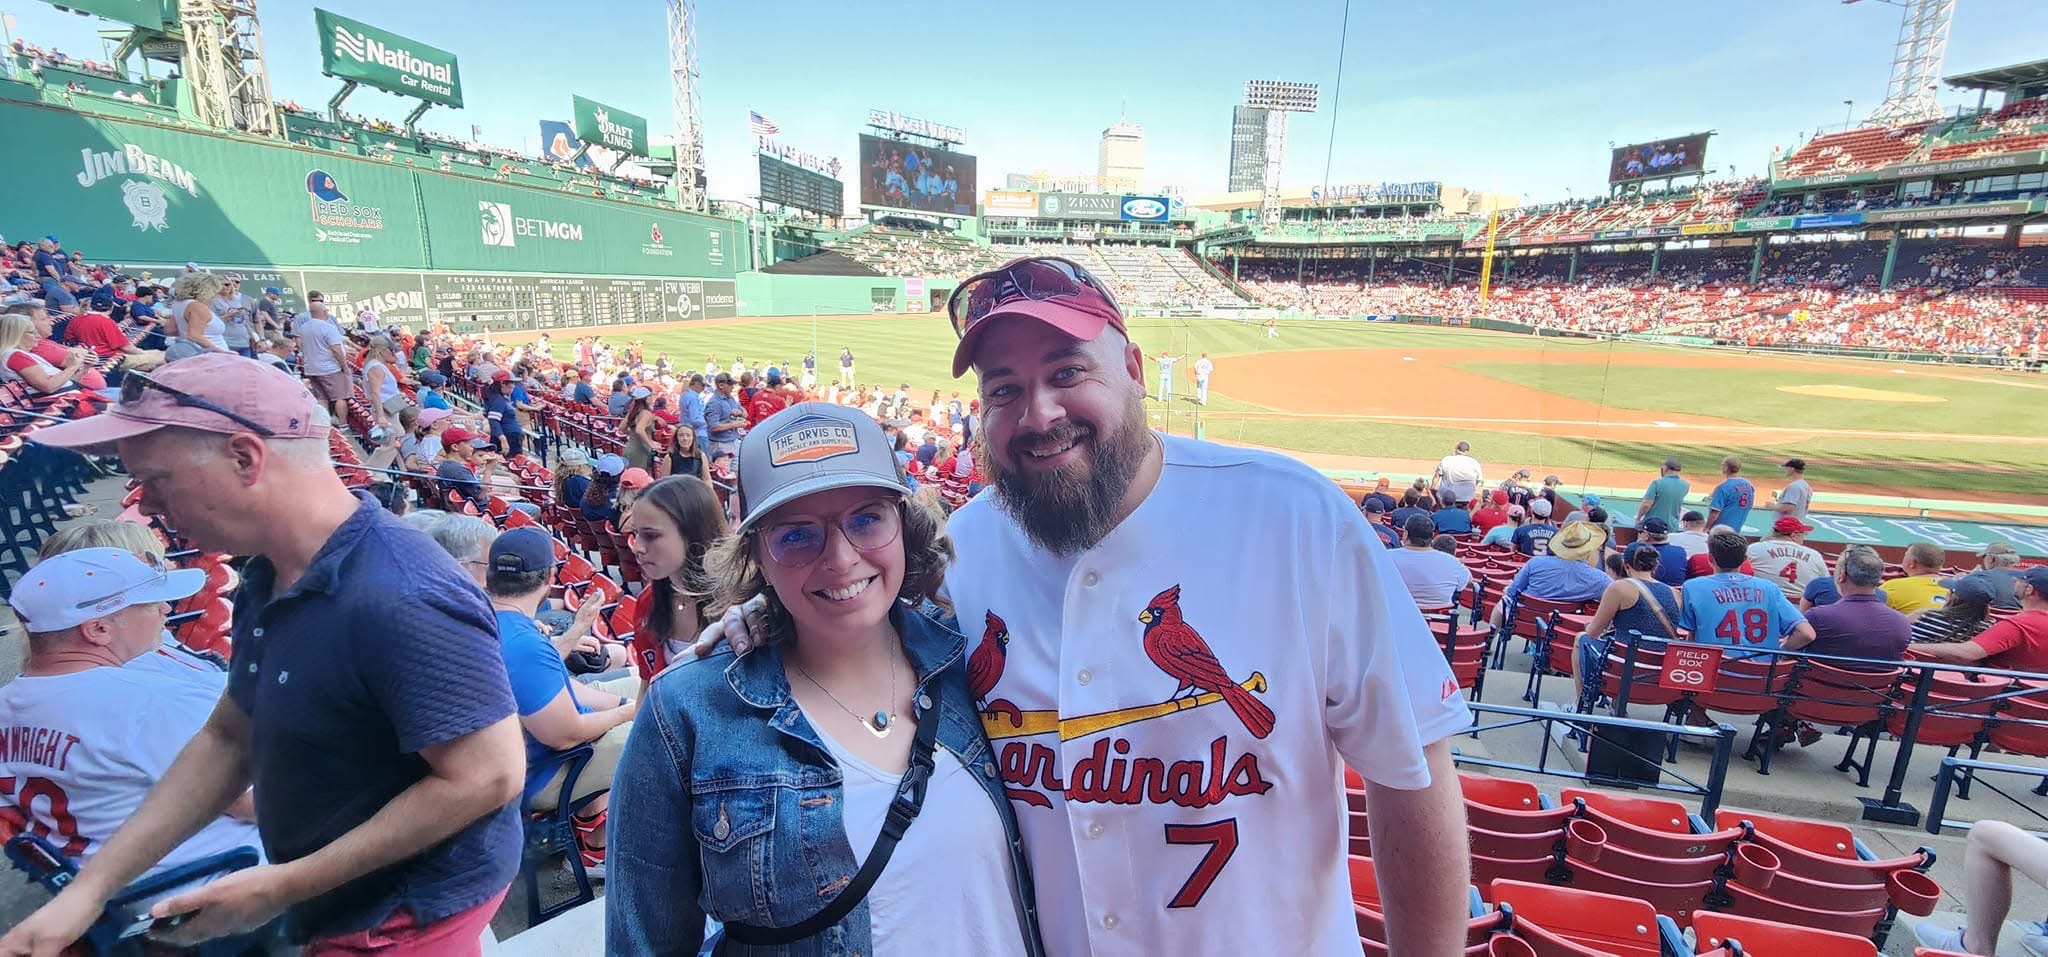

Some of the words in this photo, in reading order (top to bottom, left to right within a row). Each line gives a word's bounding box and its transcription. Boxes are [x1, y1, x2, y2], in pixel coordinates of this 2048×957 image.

[400, 74, 419, 87] Car
[421, 80, 451, 97] Rental
[598, 119, 634, 139] DRAFT
[603, 132, 633, 150] KINGS
[76, 147, 127, 188] JIM
[124, 143, 198, 198] BEAM
[1898, 165, 1937, 176] WELCOME
[1940, 164, 1950, 172] TO
[1951, 159, 1990, 170] FENWAY
[1990, 157, 2016, 168] PARK
[1311, 185, 1371, 202] SAMUEL
[1376, 181, 1437, 197] ADAMS
[319, 202, 348, 215] RED
[353, 206, 382, 220] SOX
[1068, 197, 1116, 209] ZENNI
[319, 214, 383, 230] SCHOLARS
[515, 216, 583, 241] BETMGM
[253, 273, 281, 281] EAST
[679, 282, 701, 294] WEBB
[705, 293, 734, 304] moderna
[775, 434, 793, 450] THE
[798, 428, 829, 441] ORVIS
[834, 428, 851, 439] CO.
[786, 443, 807, 453] TACKLE
[1528, 529, 1555, 539] WRIGHT
[1766, 547, 1811, 563] MOLINA
[1779, 561, 1797, 584] 4
[1712, 586, 1763, 604] BADER
[1715, 607, 1768, 645] 48
[1676, 649, 1709, 660] FIELD
[1679, 658, 1703, 668] BOX
[1669, 668, 1704, 685] 69
[1000, 735, 1274, 811] ardinals
[1164, 817, 1240, 909] 7
